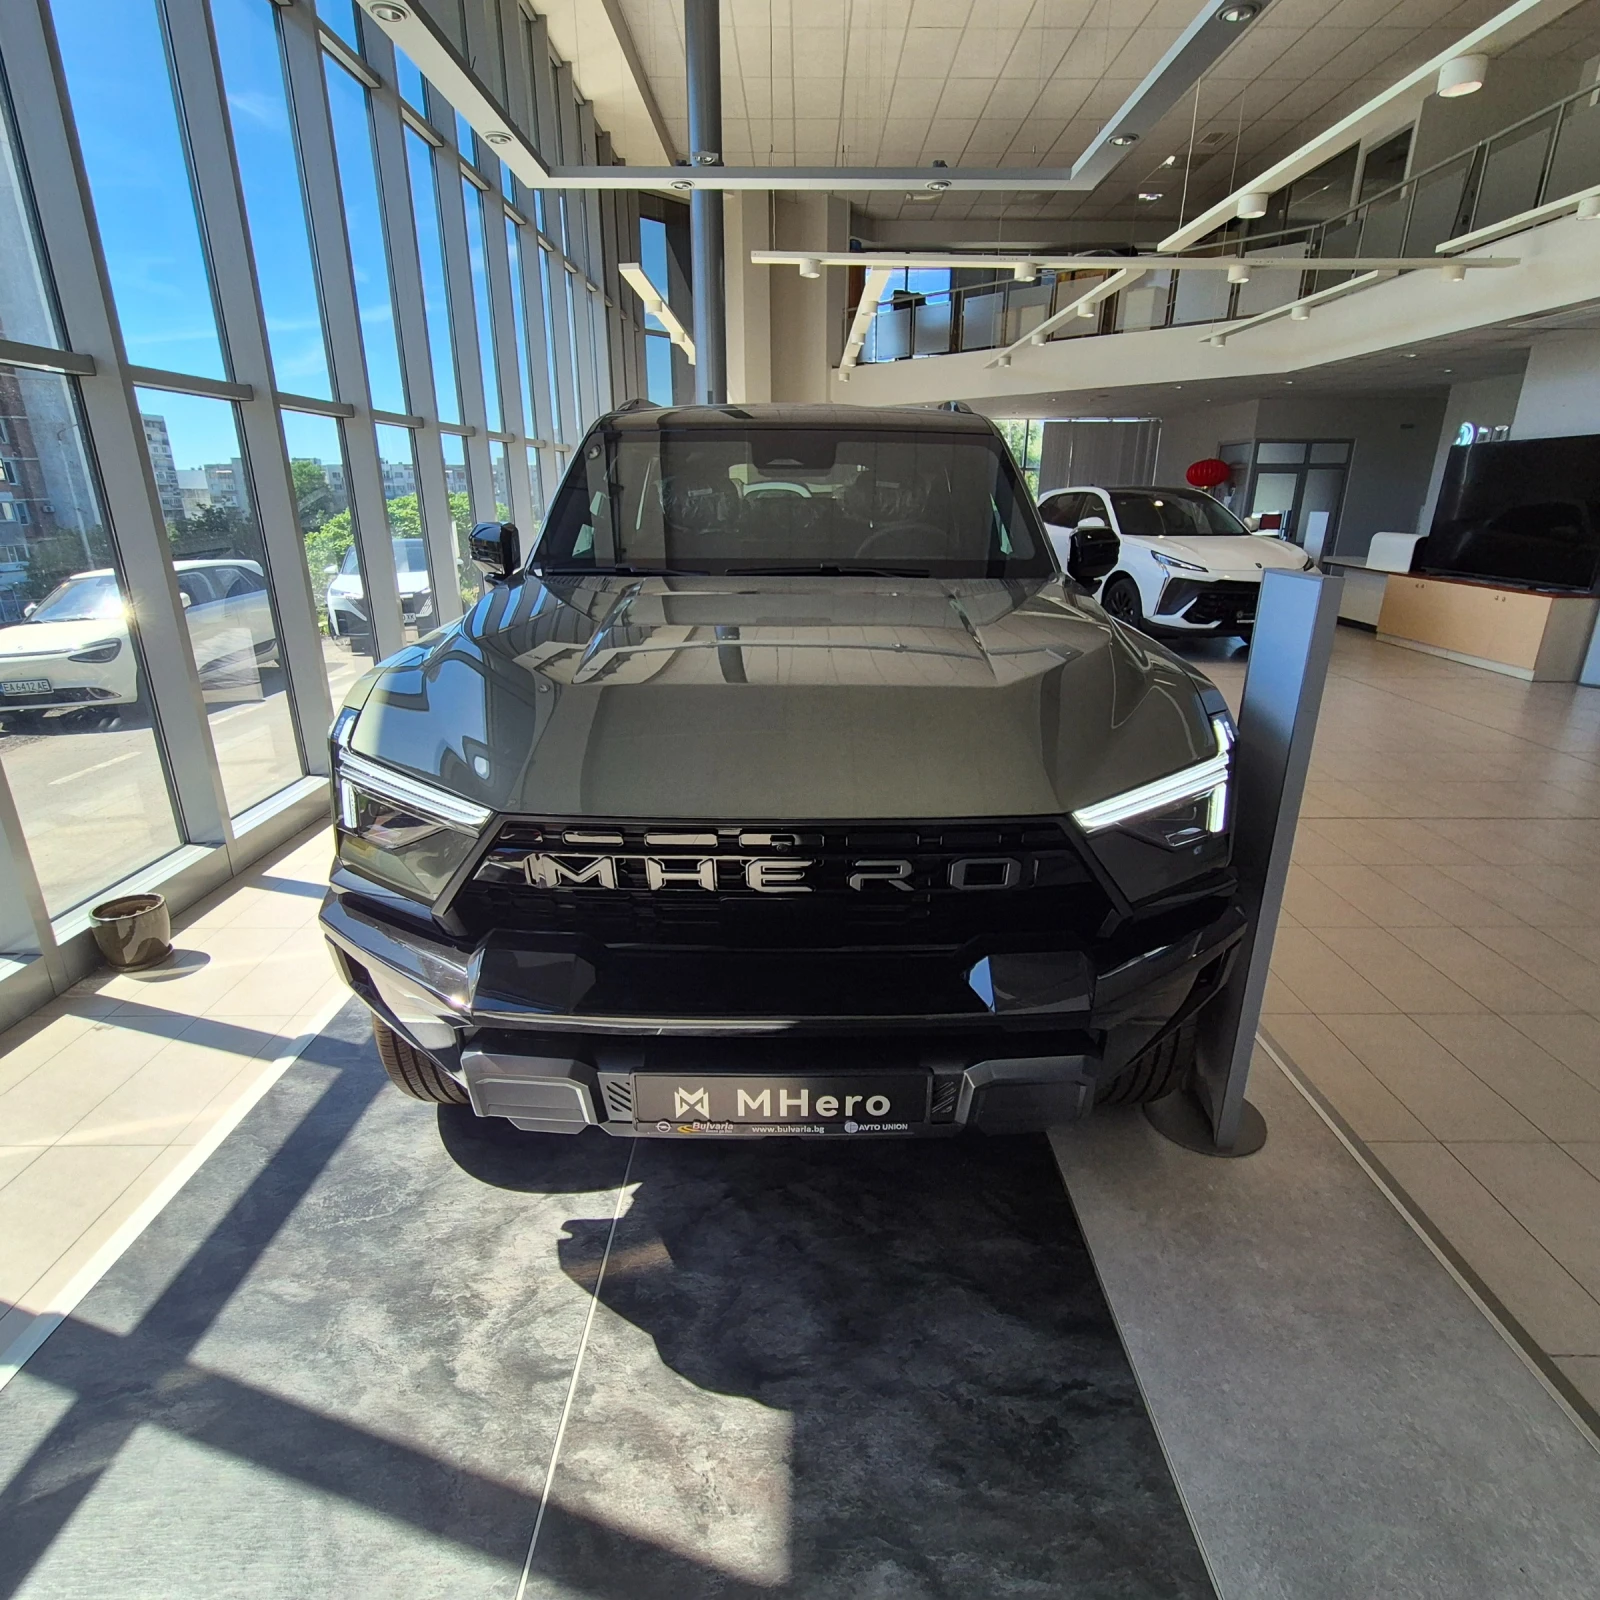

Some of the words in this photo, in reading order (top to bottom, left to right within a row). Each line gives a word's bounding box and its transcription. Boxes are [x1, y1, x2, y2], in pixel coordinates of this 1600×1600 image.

[538, 853, 1022, 893] MHERO
[737, 1089, 891, 1117] MHero
[692, 1121, 734, 1131] Bulvaria
[751, 1125, 825, 1134] www.bulvaria.bg
[881, 1123, 908, 1131] UNION
